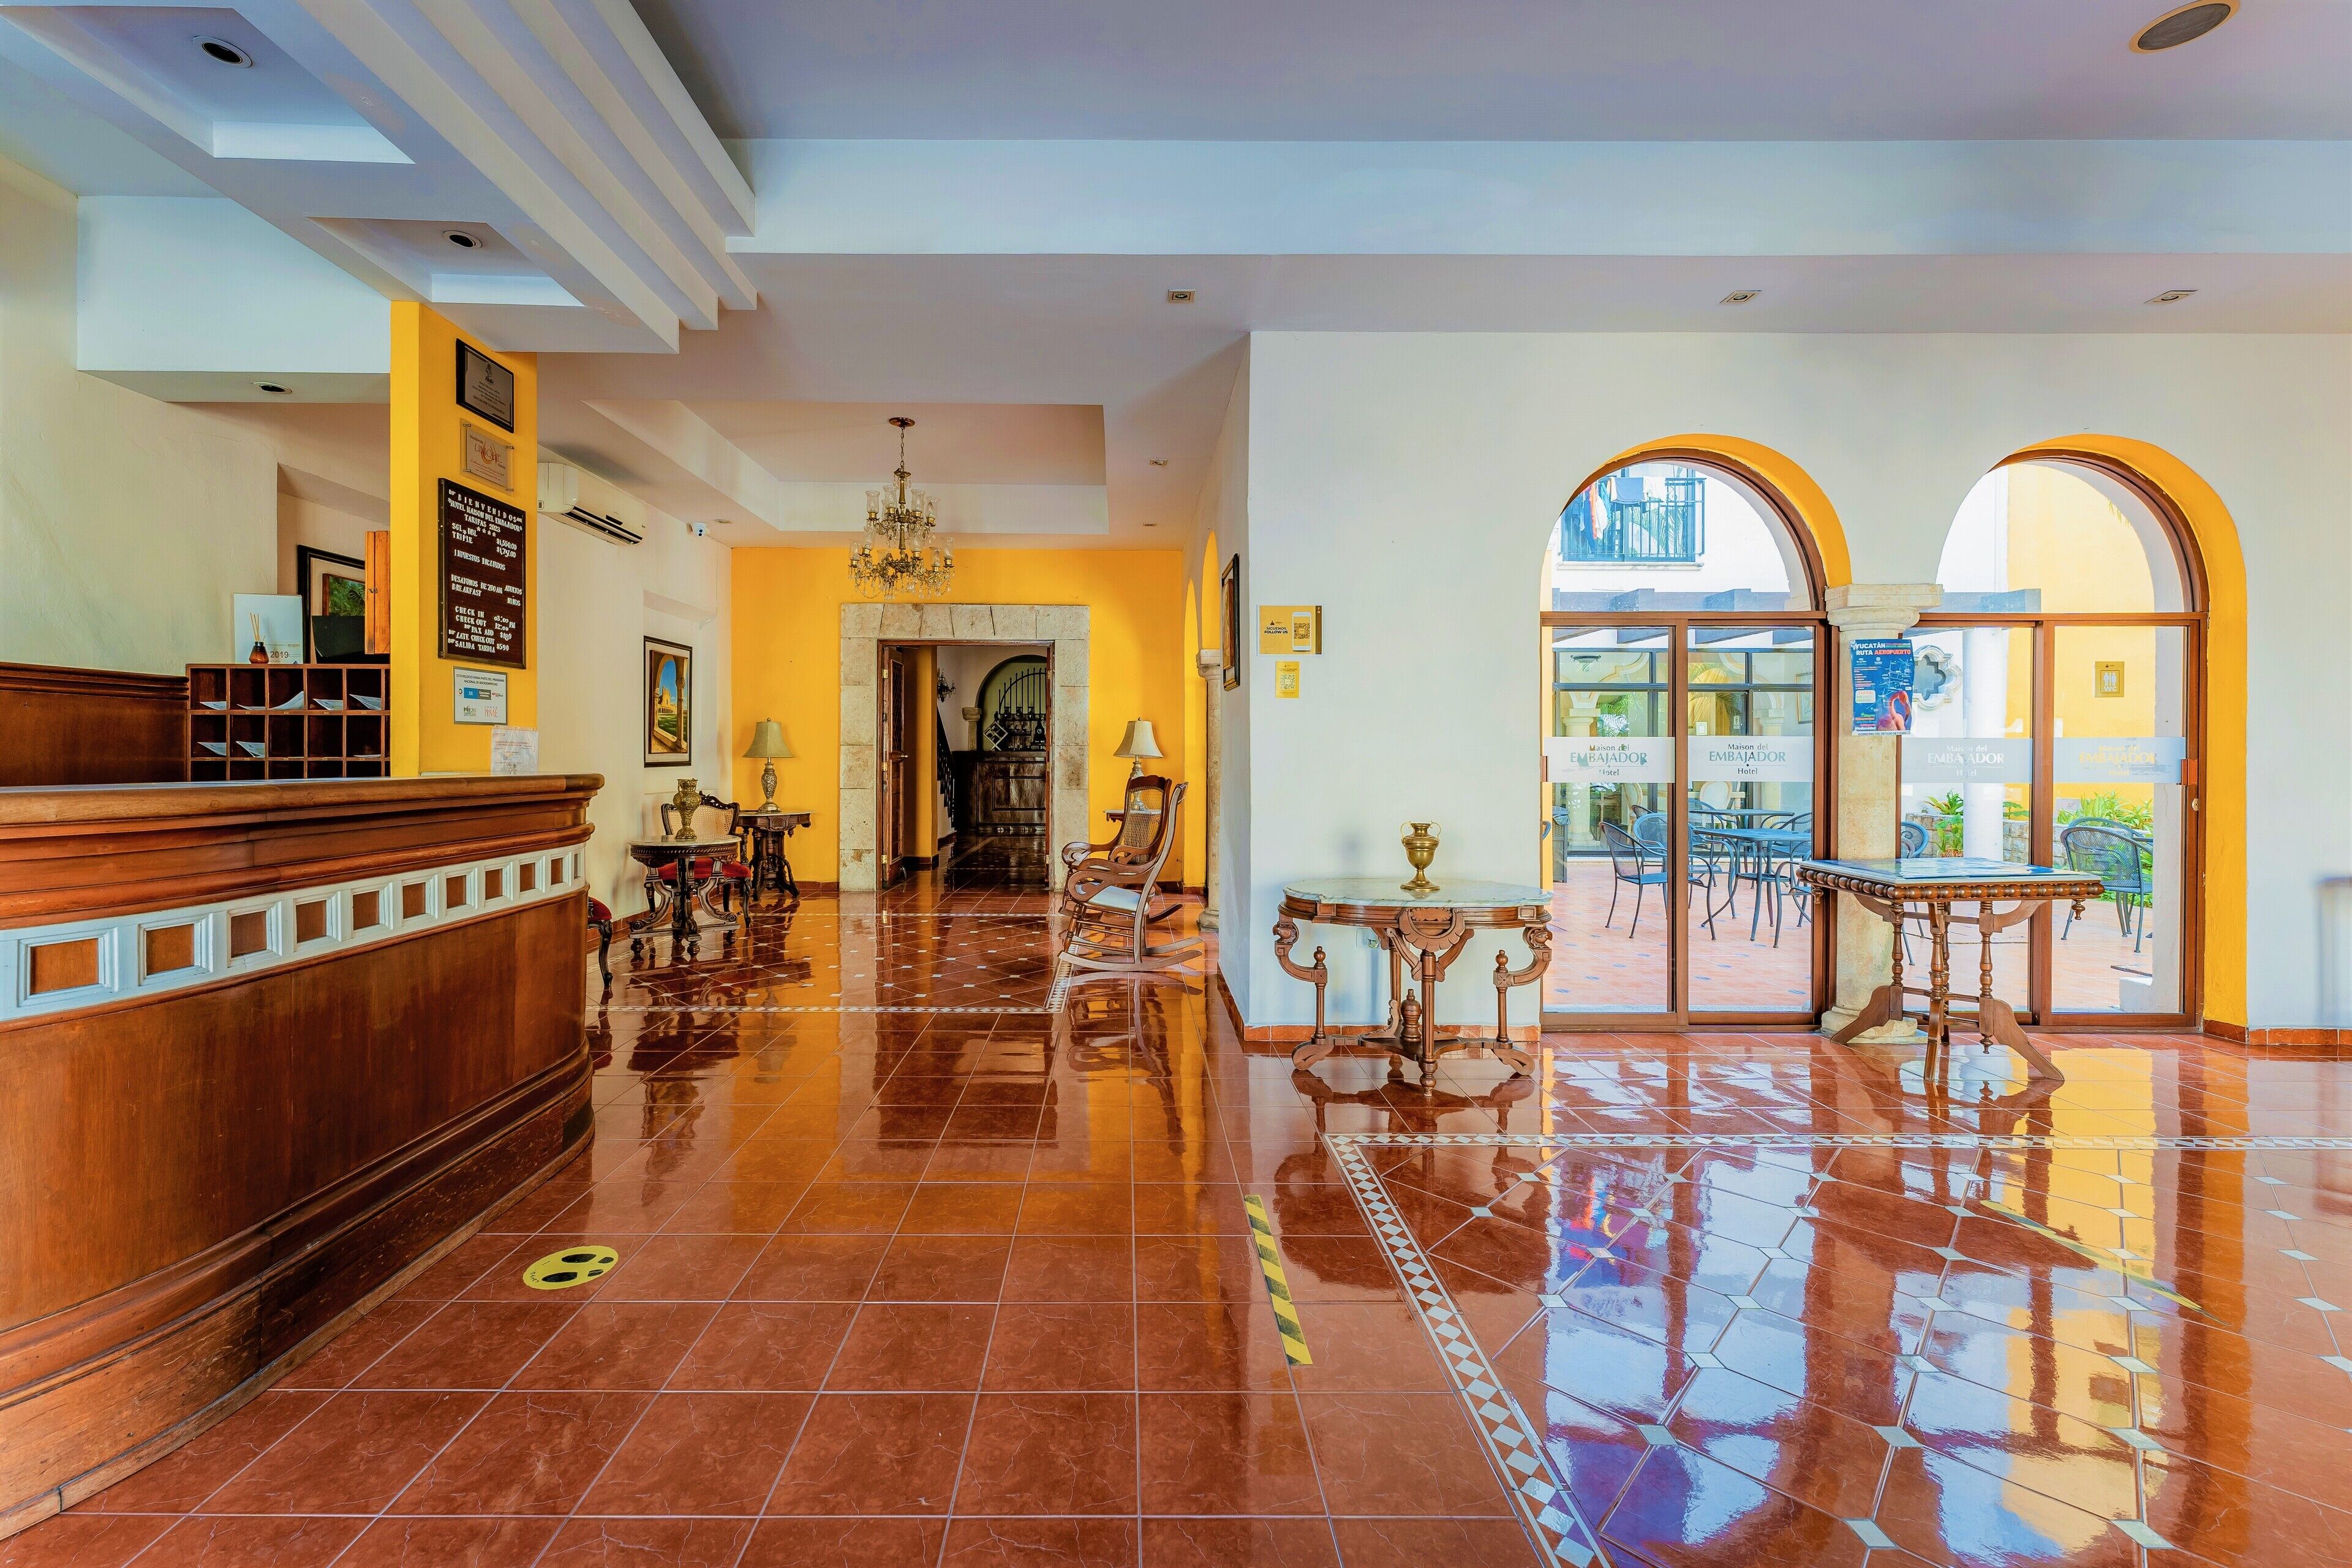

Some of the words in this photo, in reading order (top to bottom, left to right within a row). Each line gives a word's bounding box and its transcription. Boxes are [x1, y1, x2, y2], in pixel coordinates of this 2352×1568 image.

[450, 500, 466, 511] HOTEL
[485, 513, 494, 522] DEL
[458, 494, 517, 522] BIENVENIDOS
[464, 514, 486, 527] TARIFAS
[452, 531, 473, 544] TRIPLE
[452, 583, 482, 597] BREAKFAST
[455, 606, 475, 616] CHECK
[456, 614, 475, 625] CHECK
[476, 619, 487, 627] OUT
[456, 632, 469, 641] LATE
[455, 640, 475, 650] SALIDA
[1570, 752, 1647, 764] EMBAJADOR
[1709, 751, 1786, 763] EMBAJADOR
[2079, 752, 2157, 764] EMBAJADOR
